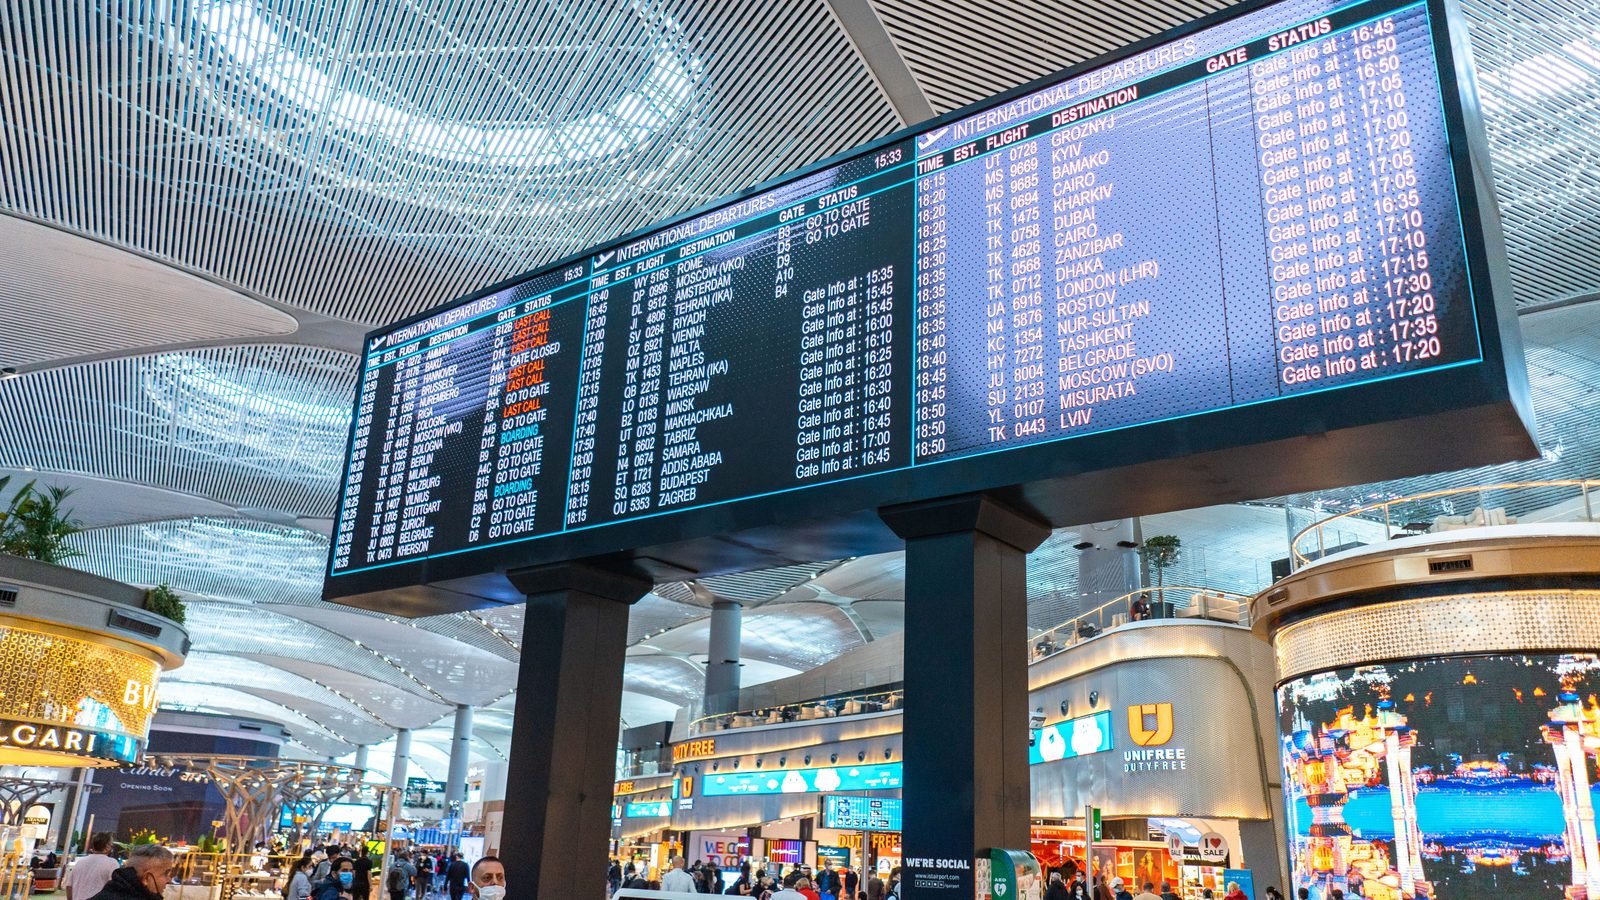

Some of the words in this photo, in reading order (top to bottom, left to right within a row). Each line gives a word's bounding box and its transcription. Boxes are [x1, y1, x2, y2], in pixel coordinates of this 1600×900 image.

[918, 154, 943, 175] TIME
[954, 142, 978, 162] EST.
[986, 124, 1028, 151] FLIGHT
[1052, 85, 1137, 128] DESTINATION
[1206, 47, 1246, 74] GATE
[1268, 17, 1331, 52] STATUS
[918, 172, 945, 193] 18:15
[985, 153, 1001, 170] UT
[1010, 140, 1037, 162] 0728
[1051, 114, 1115, 148] GROZNYJ
[1252, 54, 1285, 78] Gate
[1291, 43, 1318, 65] Info
[1323, 38, 1337, 54] at
[1350, 16, 1394, 45] 16:45
[954, 86, 1075, 140] INTERNATIONAL
[1079, 38, 1196, 92] DEPARTURES
[616, 221, 696, 262] INTERNATIONAL
[699, 191, 774, 232] DEPARTURES
[874, 148, 901, 169] 15:33
[917, 250, 945, 271] 18:30
[986, 233, 1002, 251] TK
[1011, 222, 1040, 243] 0758
[1054, 205, 1095, 231] DUBAI
[1261, 144, 1295, 168] Gate
[1301, 133, 1329, 156] Info
[1334, 129, 1349, 146] at
[1362, 110, 1408, 138] 17:00
[589, 289, 609, 305] 16:40
[634, 275, 648, 289] WY
[650, 267, 669, 284] 5163
[677, 256, 703, 274] ROME
[778, 225, 790, 239] B3
[807, 214, 822, 230] GO
[824, 208, 837, 224] TO
[840, 197, 869, 218] GATE
[591, 274, 609, 289] TIME
[615, 265, 632, 281] EST.
[636, 254, 664, 273] FLIGHT
[679, 229, 735, 258] DESTINATION
[779, 204, 804, 223] GATE
[818, 185, 857, 209] STATUS
[367, 354, 380, 367] TIME
[383, 348, 397, 362] EST.
[399, 340, 420, 356] FLIGHT
[428, 323, 468, 346] DESTINATION
[497, 307, 516, 323] GATE
[524, 294, 551, 313] STATUS
[386, 315, 440, 346] INTERNATIONAL
[444, 294, 497, 325] DEPARTURES
[564, 266, 582, 282] 15:33
[585, 328, 605, 344] 17:00
[630, 317, 637, 329] JI
[646, 308, 666, 324] 4806
[674, 294, 710, 316] TEHRAN
[711, 286, 733, 306] (IKA)
[776, 267, 793, 283] A10
[586, 315, 606, 331] 17:00
[631, 302, 642, 316] DL
[647, 294, 667, 311] 9512
[675, 273, 731, 302] AMSTERDAM
[777, 254, 790, 269] D9
[916, 349, 945, 370] 18:40
[988, 335, 1005, 353] KC
[1013, 325, 1042, 347] 1354
[1057, 299, 1149, 336] NUR-SULTAN
[1272, 259, 1307, 282] Gate
[1313, 250, 1343, 272] Info
[1348, 247, 1364, 264] at
[1378, 229, 1425, 257] 17:10
[351, 448, 366, 461] 16:10
[383, 440, 392, 452] UT
[413, 426, 444, 444] MOSCOW
[443, 420, 463, 436] (VKO)
[484, 411, 494, 424] A6
[503, 403, 521, 418] LAST
[522, 398, 540, 413] CALL
[573, 438, 594, 453] 17:50
[619, 428, 631, 441] UT
[636, 422, 656, 437] 0730
[664, 402, 733, 431] MAKHACHKALA
[799, 380, 822, 397] Gate
[824, 375, 842, 391] Info
[845, 373, 854, 386] at
[864, 363, 891, 381] 16:20
[915, 437, 944, 457] 18:50
[989, 425, 1005, 443] TK
[1015, 417, 1045, 438] 0443
[1060, 408, 1091, 429] LVIV
[1282, 361, 1318, 384] Gate
[1325, 354, 1356, 376] Info
[1360, 351, 1377, 369] at
[1391, 336, 1441, 363] 17:20
[404, 490, 429, 506] VILNIUS
[475, 475, 489, 489] B15
[495, 471, 507, 484] GO
[508, 468, 519, 481] TO
[520, 462, 541, 478] GATE
[566, 510, 586, 525] 18:15
[613, 501, 626, 515] OU
[629, 497, 650, 512] 5353
[658, 487, 696, 506] ZAGREB
[795, 462, 819, 479] Gate
[821, 458, 840, 474] Info
[842, 457, 852, 470] at
[862, 448, 890, 466] 16:45
[333, 557, 348, 569] 16:35
[365, 551, 375, 563] TK
[397, 540, 429, 557] KHERSON
[468, 529, 479, 542] D6
[488, 524, 500, 538] GO
[501, 522, 512, 535] TO
[513, 517, 534, 533] GATE
[690, 740, 715, 756] FREE
[1124, 748, 1185, 761] UNIFREE
[1124, 760, 1186, 772] DUTYFREE
[838, 834, 864, 849] DUT
[872, 833, 897, 849] FREE
[906, 857, 934, 868] WE'RE
[936, 858, 970, 869] SOCIAL
[1205, 838, 1209, 848] I
